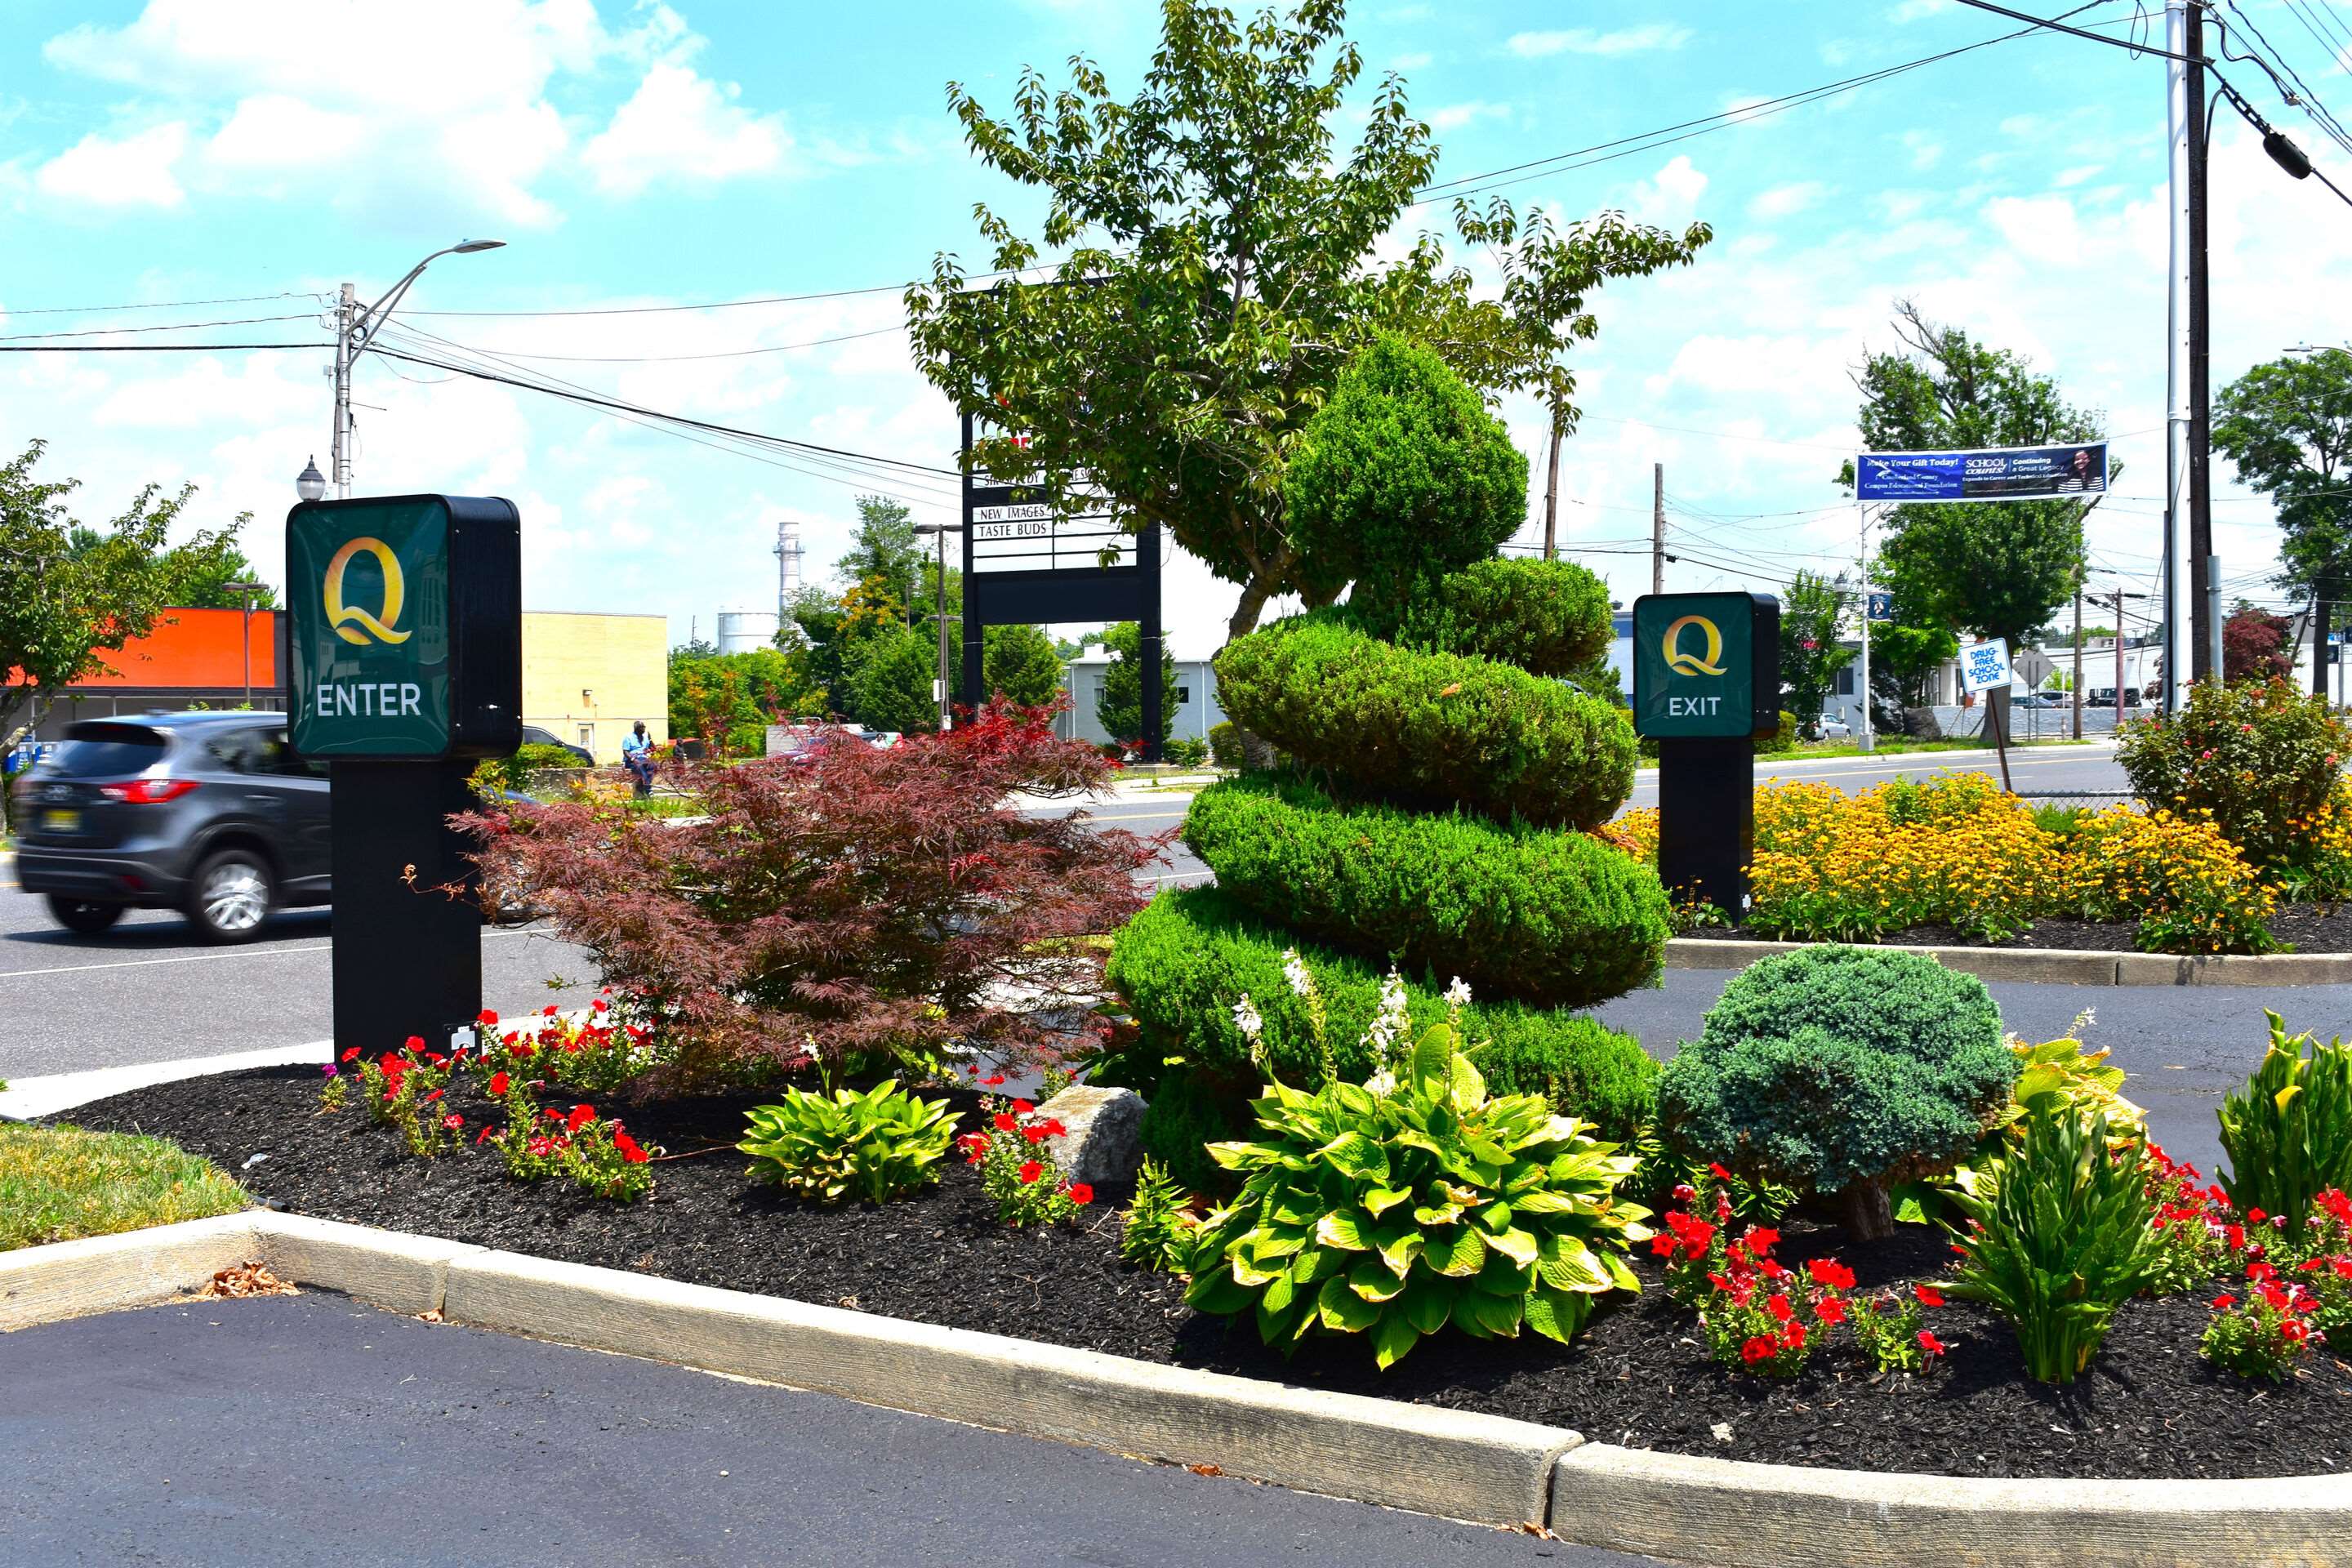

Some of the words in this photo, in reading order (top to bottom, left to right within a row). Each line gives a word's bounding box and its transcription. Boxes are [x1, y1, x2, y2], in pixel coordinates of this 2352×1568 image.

[1929, 458, 1959, 467] Today!
[1966, 458, 2005, 468] SCHOOL
[2012, 457, 2051, 466] Continuing
[980, 508, 1003, 520] NEW
[1008, 506, 1045, 519] IMAGES
[979, 525, 1012, 537] TASTE
[1018, 523, 1047, 536] BUDS
[323, 536, 412, 646] Q
[1662, 614, 1728, 677] Q
[1970, 647, 1999, 660] DRUG-
[1975, 656, 1996, 667] FREE
[1968, 662, 2005, 678] SCHOOL
[1976, 671, 2000, 684] ZONE
[317, 683, 421, 717] ENTER
[1669, 697, 1722, 716] EXIT
